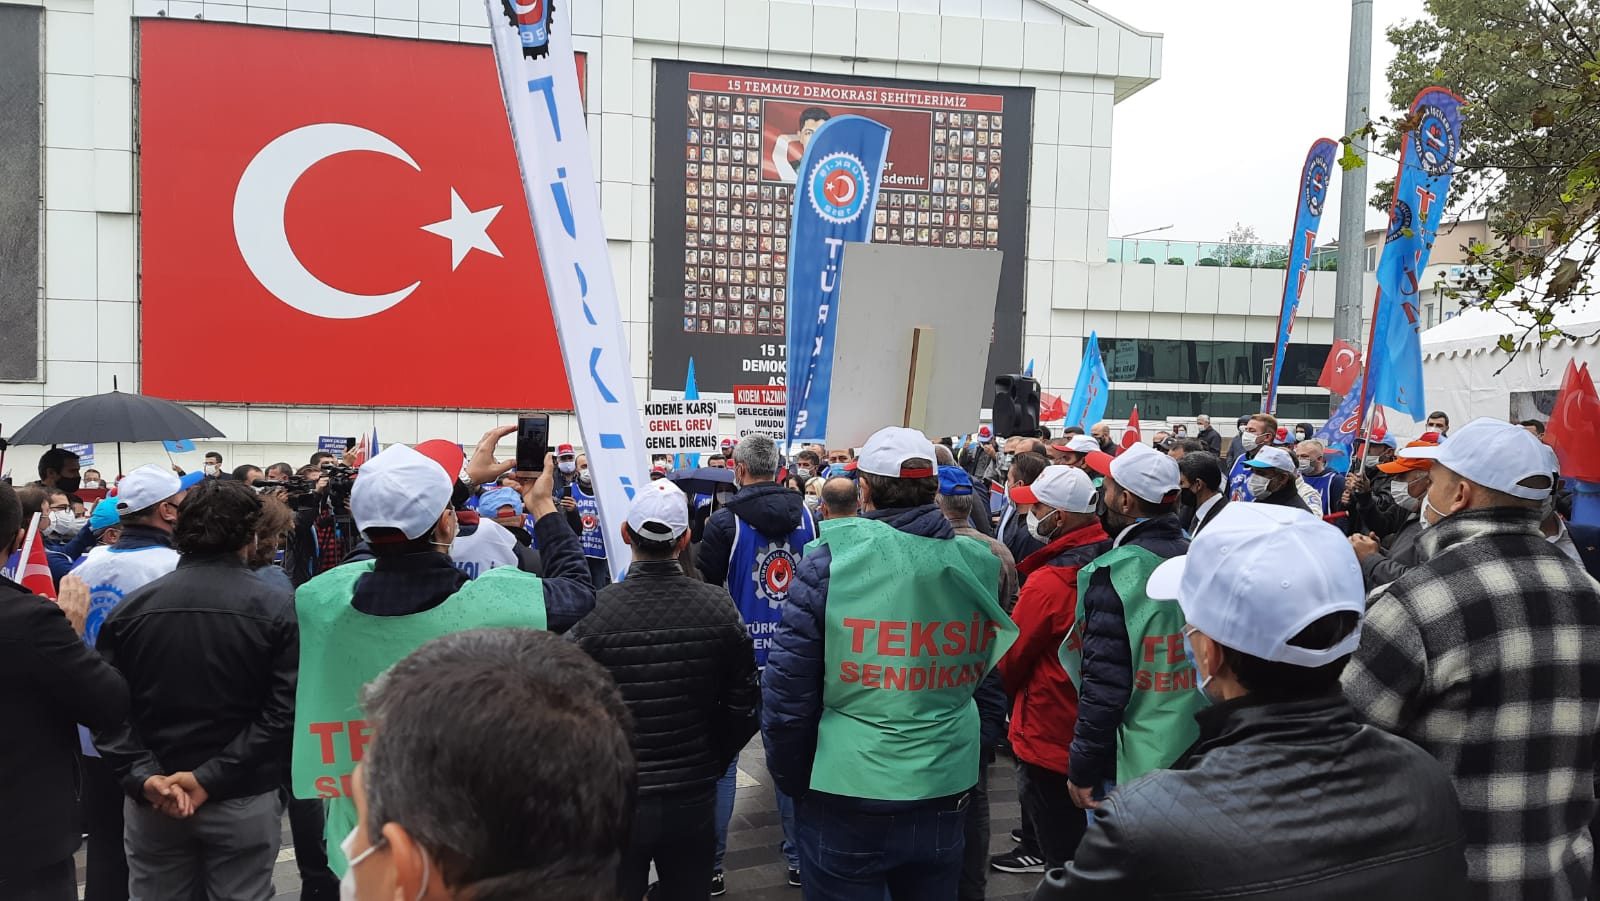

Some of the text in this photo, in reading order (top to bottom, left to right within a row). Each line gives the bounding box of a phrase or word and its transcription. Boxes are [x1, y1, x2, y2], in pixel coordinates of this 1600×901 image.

[727, 79, 967, 108] 15 TEMMUZ DEMOKRASİ ŞEHİTLERİMİZ
[760, 343, 776, 357] 15
[742, 359, 787, 373] DEMOK
[737, 387, 787, 404] KIDEM TAZMİN
[644, 401, 717, 417] KIDEME KARŞI
[737, 406, 786, 418] GELECEĞİMİ
[649, 418, 713, 432] GENEL GREV
[754, 419, 784, 429] UMUDU
[645, 432, 718, 450] GENEL DİRENİŞ
[842, 611, 1003, 657] TEKSİF
